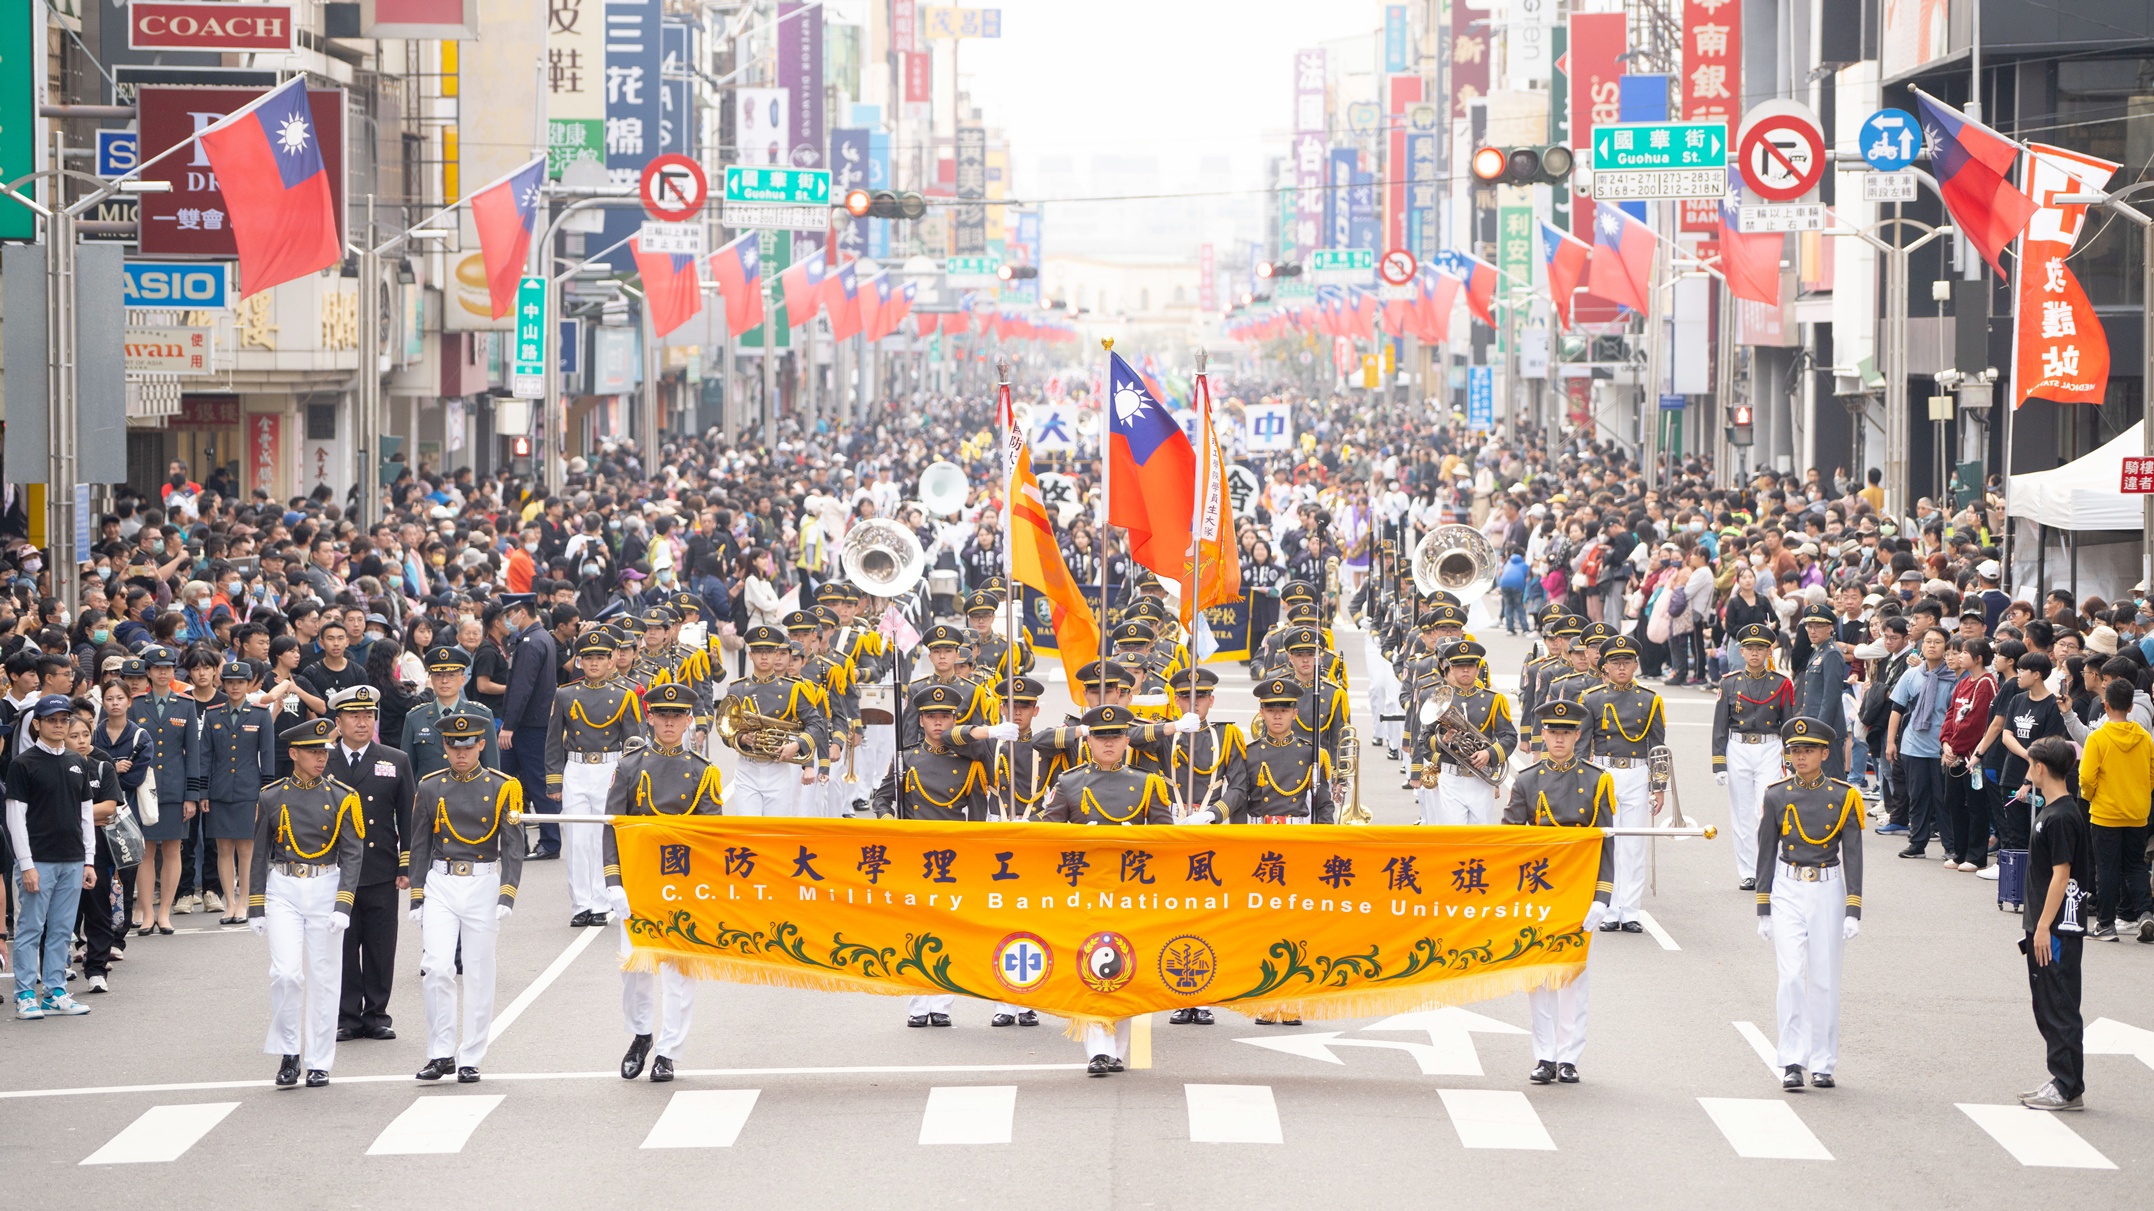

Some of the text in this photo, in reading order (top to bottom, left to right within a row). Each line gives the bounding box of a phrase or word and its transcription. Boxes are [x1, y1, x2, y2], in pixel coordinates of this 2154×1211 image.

[139, 16, 284, 38] COACH
[1614, 128, 1706, 151] 國華街
[1617, 151, 1702, 165] Guohua St.
[1663, 172, 1710, 183] 273-283
[744, 188, 811, 201] Guohua St.
[1663, 184, 1710, 194] 212-218
[1686, 211, 1719, 223] BAN
[1744, 207, 1819, 219] 三輪以上車輛
[1745, 219, 1818, 231] 禁止右轉
[521, 302, 540, 361] 中山路
[191, 333, 203, 369] 使用
[1035, 412, 1072, 443] 大
[1254, 412, 1285, 443] 中
[314, 447, 329, 482] 金美
[659, 844, 1555, 895] 國防大學理工學院風嶺樂儀旗隊
[799, 886, 962, 912] Military
[1247, 893, 1373, 914] Defense
[1391, 899, 1552, 922] University
